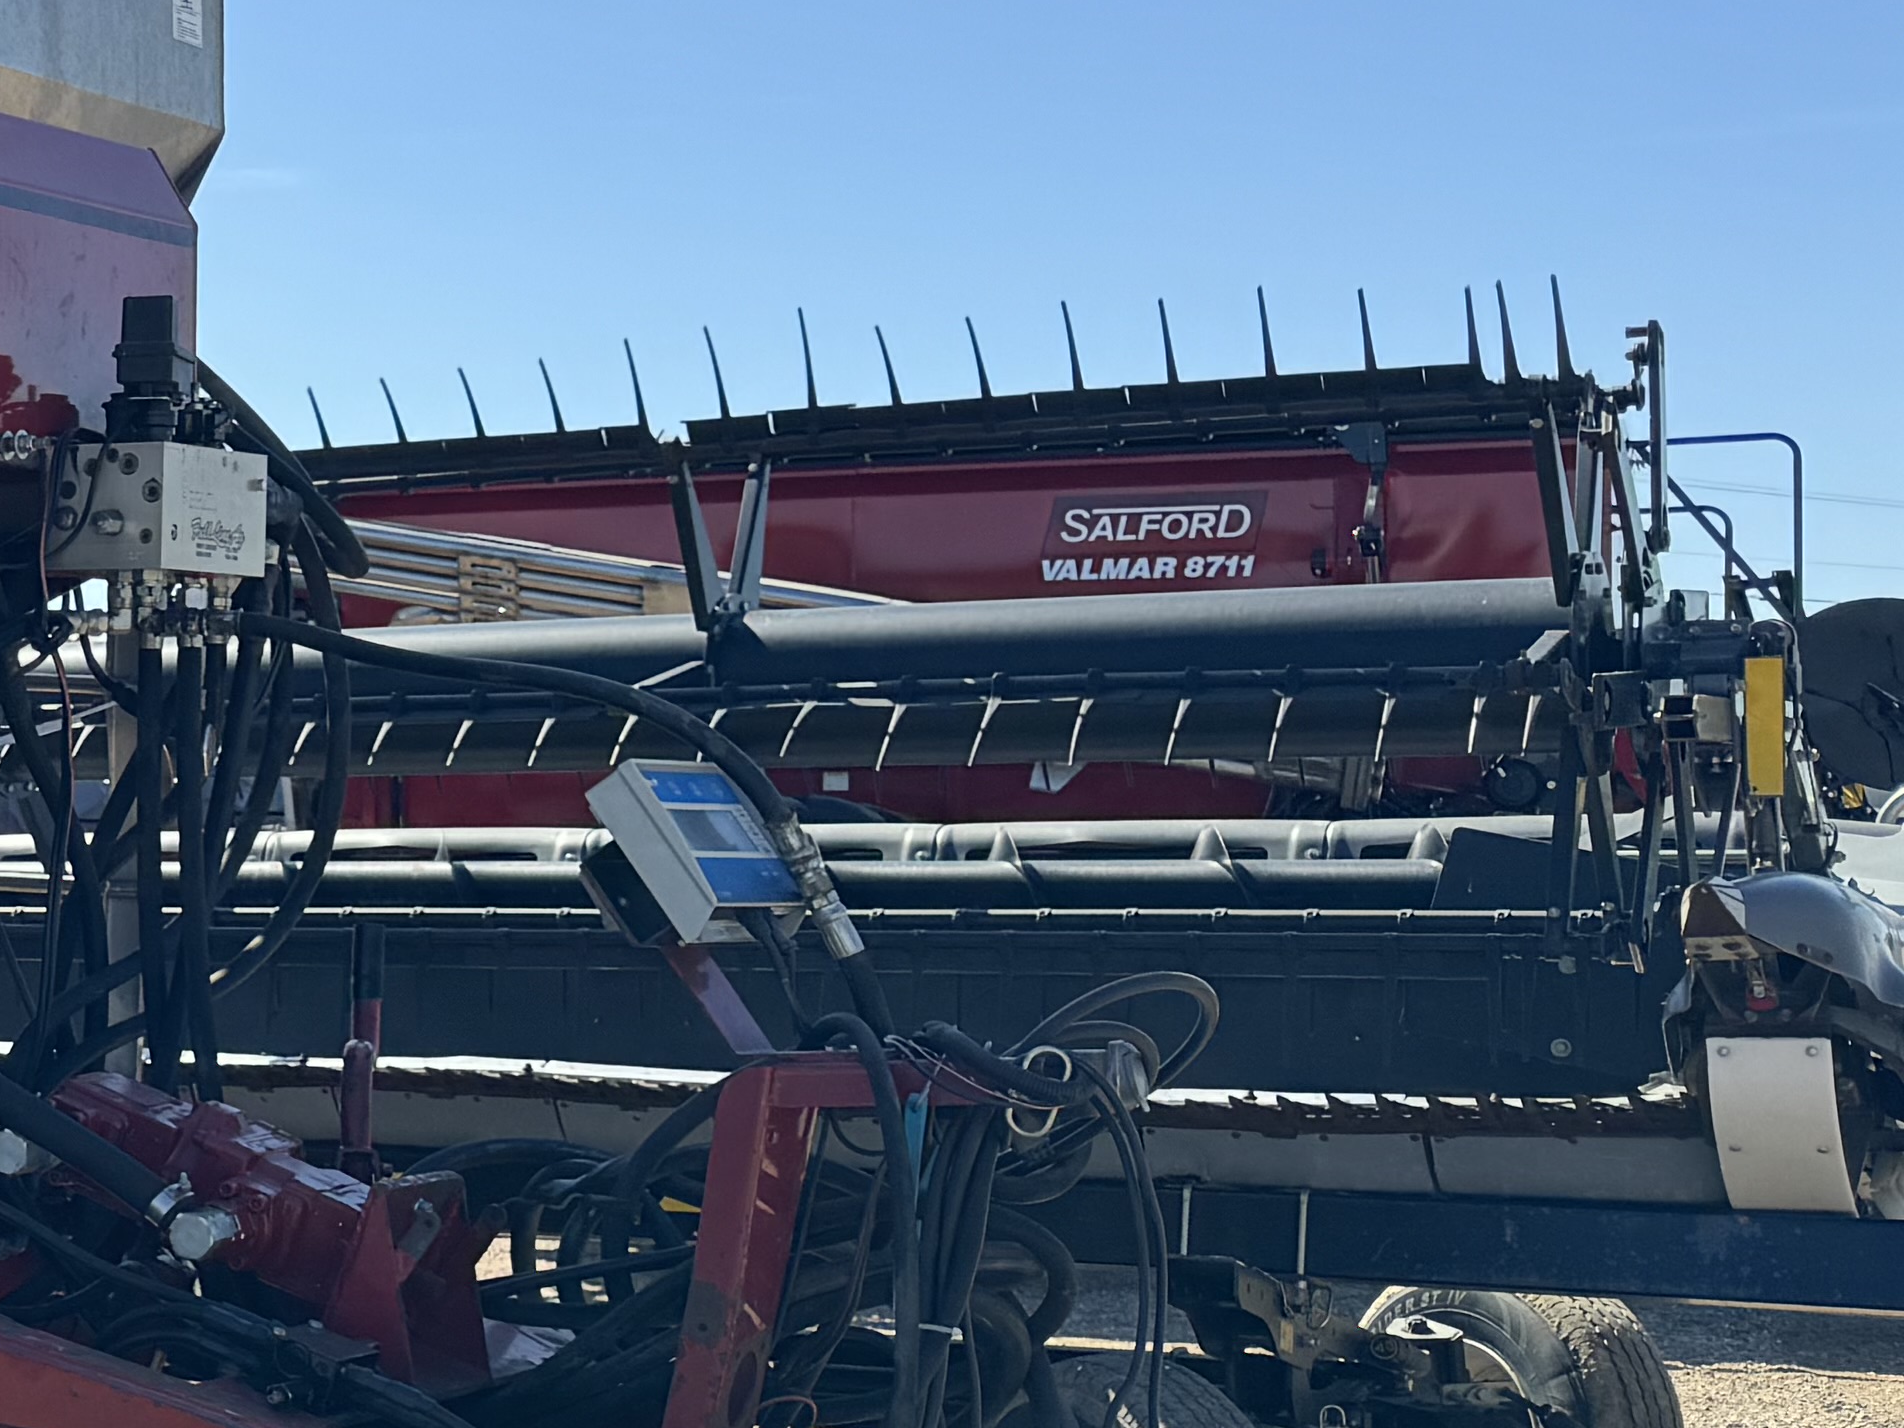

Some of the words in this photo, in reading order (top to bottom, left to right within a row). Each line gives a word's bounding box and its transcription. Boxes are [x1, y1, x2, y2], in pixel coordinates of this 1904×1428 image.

[1059, 503, 1252, 543] SALFORD
[1041, 557, 1178, 581] VALMAR
[1183, 554, 1256, 578] 8711
